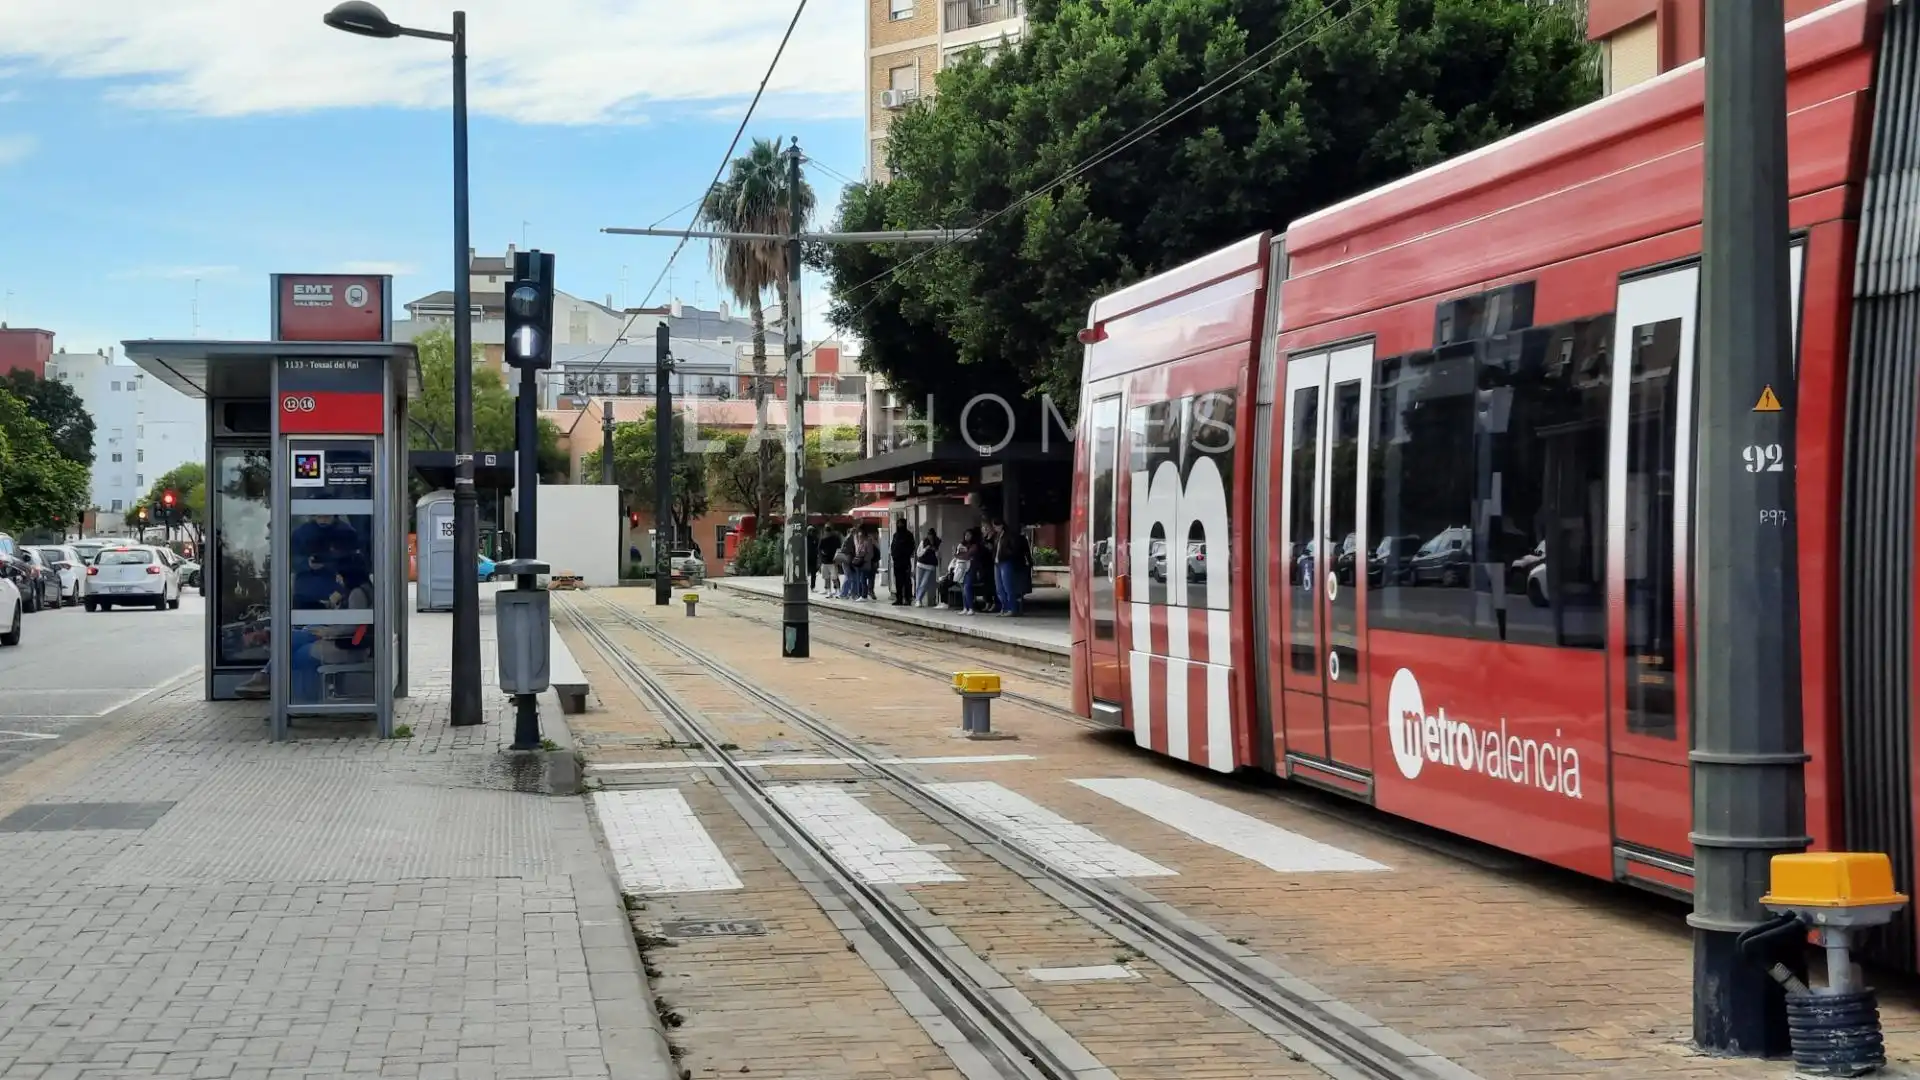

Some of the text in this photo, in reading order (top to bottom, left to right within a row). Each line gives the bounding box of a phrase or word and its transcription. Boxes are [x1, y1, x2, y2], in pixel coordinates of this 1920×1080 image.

[293, 284, 333, 294] EMT
[287, 400, 313, 409] 12 16
[1742, 444, 1784, 472] 92
[1401, 707, 1582, 799] metrovalencia
